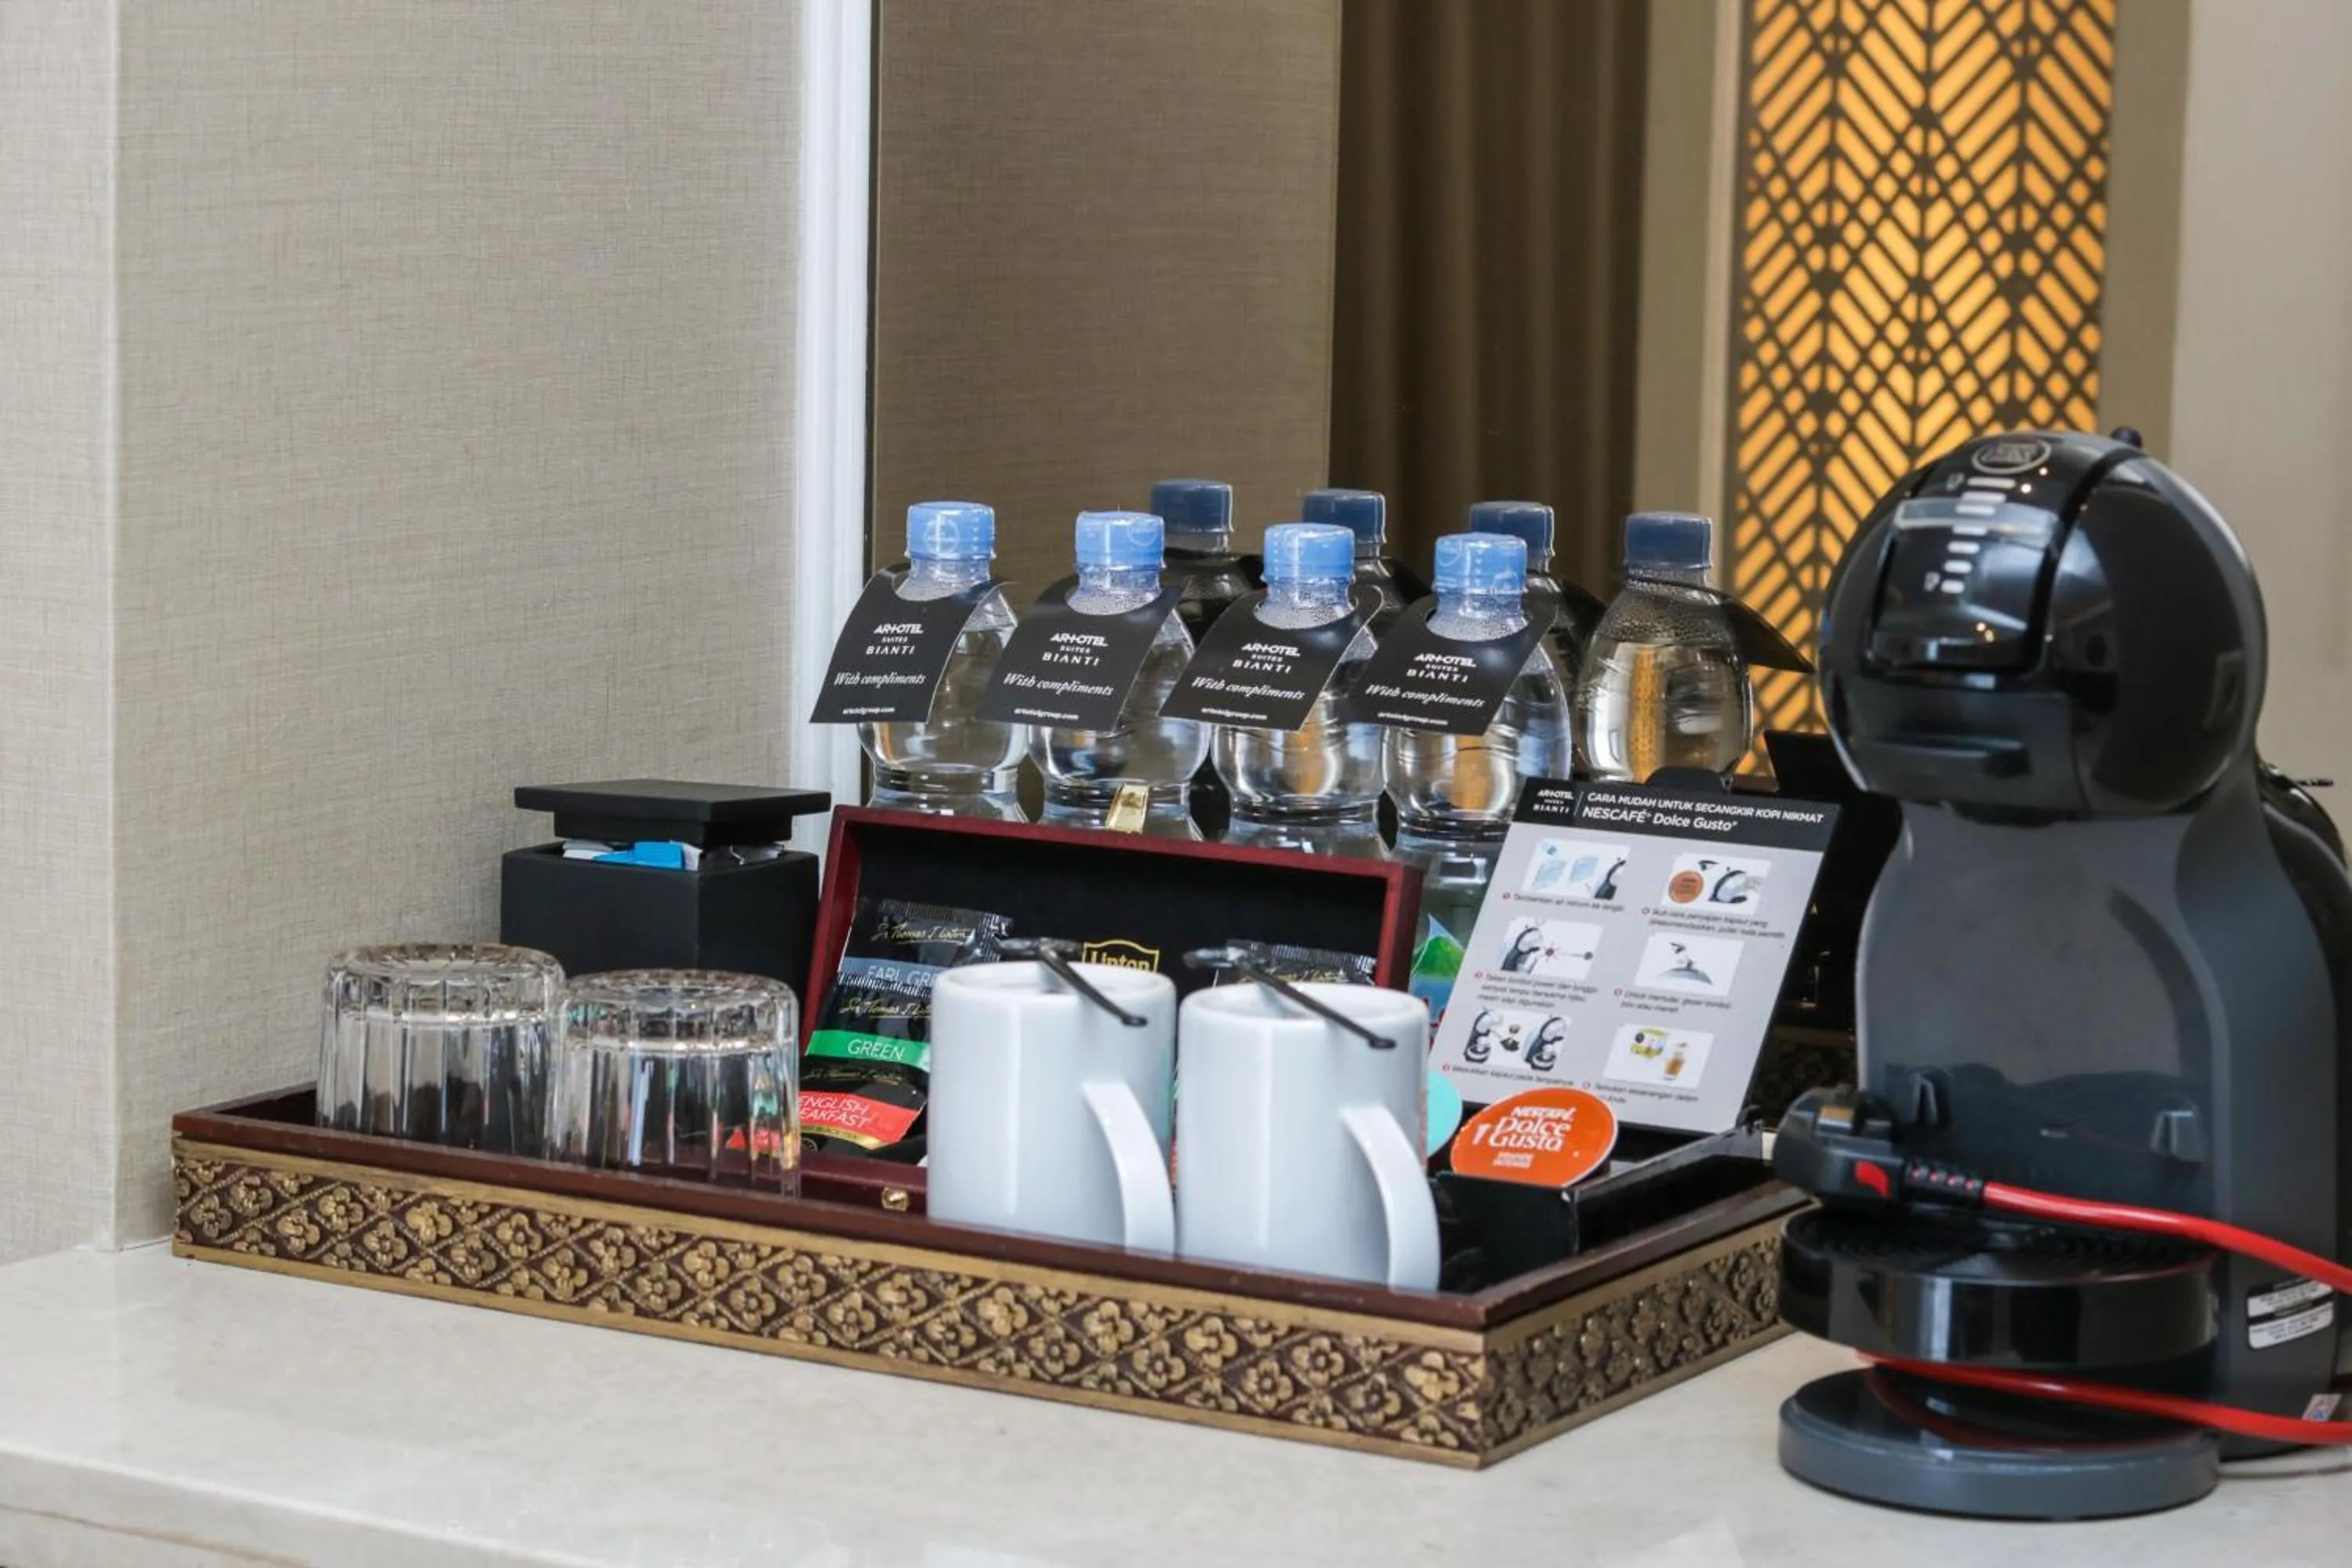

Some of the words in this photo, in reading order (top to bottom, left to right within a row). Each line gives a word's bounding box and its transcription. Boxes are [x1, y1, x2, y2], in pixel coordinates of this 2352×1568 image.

[866, 645, 916, 655] BIANTI
[1042, 652, 1100, 666] BIANTI
[1060, 645, 1091, 654] SUITES
[1232, 659, 1292, 673] BIANTI
[834, 672, 860, 686] With
[861, 672, 926, 689] compliments
[1004, 673, 1036, 688] With
[1036, 680, 1113, 695] compliments
[1406, 669, 1468, 683] BIANTI
[1192, 677, 1225, 691] With
[1225, 684, 1305, 700] compliments
[1365, 684, 1400, 697] With
[1401, 691, 1485, 708] compliments
[1588, 793, 1616, 804] CARA
[1617, 796, 1657, 808] MUDAH
[1658, 798, 1693, 811] UNTUK
[1695, 802, 1755, 816] SECANGKIR
[1756, 808, 1780, 819] KOPI
[1783, 811, 1824, 823] NIKMAT
[1653, 813, 1690, 827] Dolce
[848, 1039, 906, 1061] GREEN
[800, 1107, 872, 1128] EAKFAST
[1497, 1116, 1571, 1138] Dolce
[1489, 1133, 1563, 1152] Gusto
